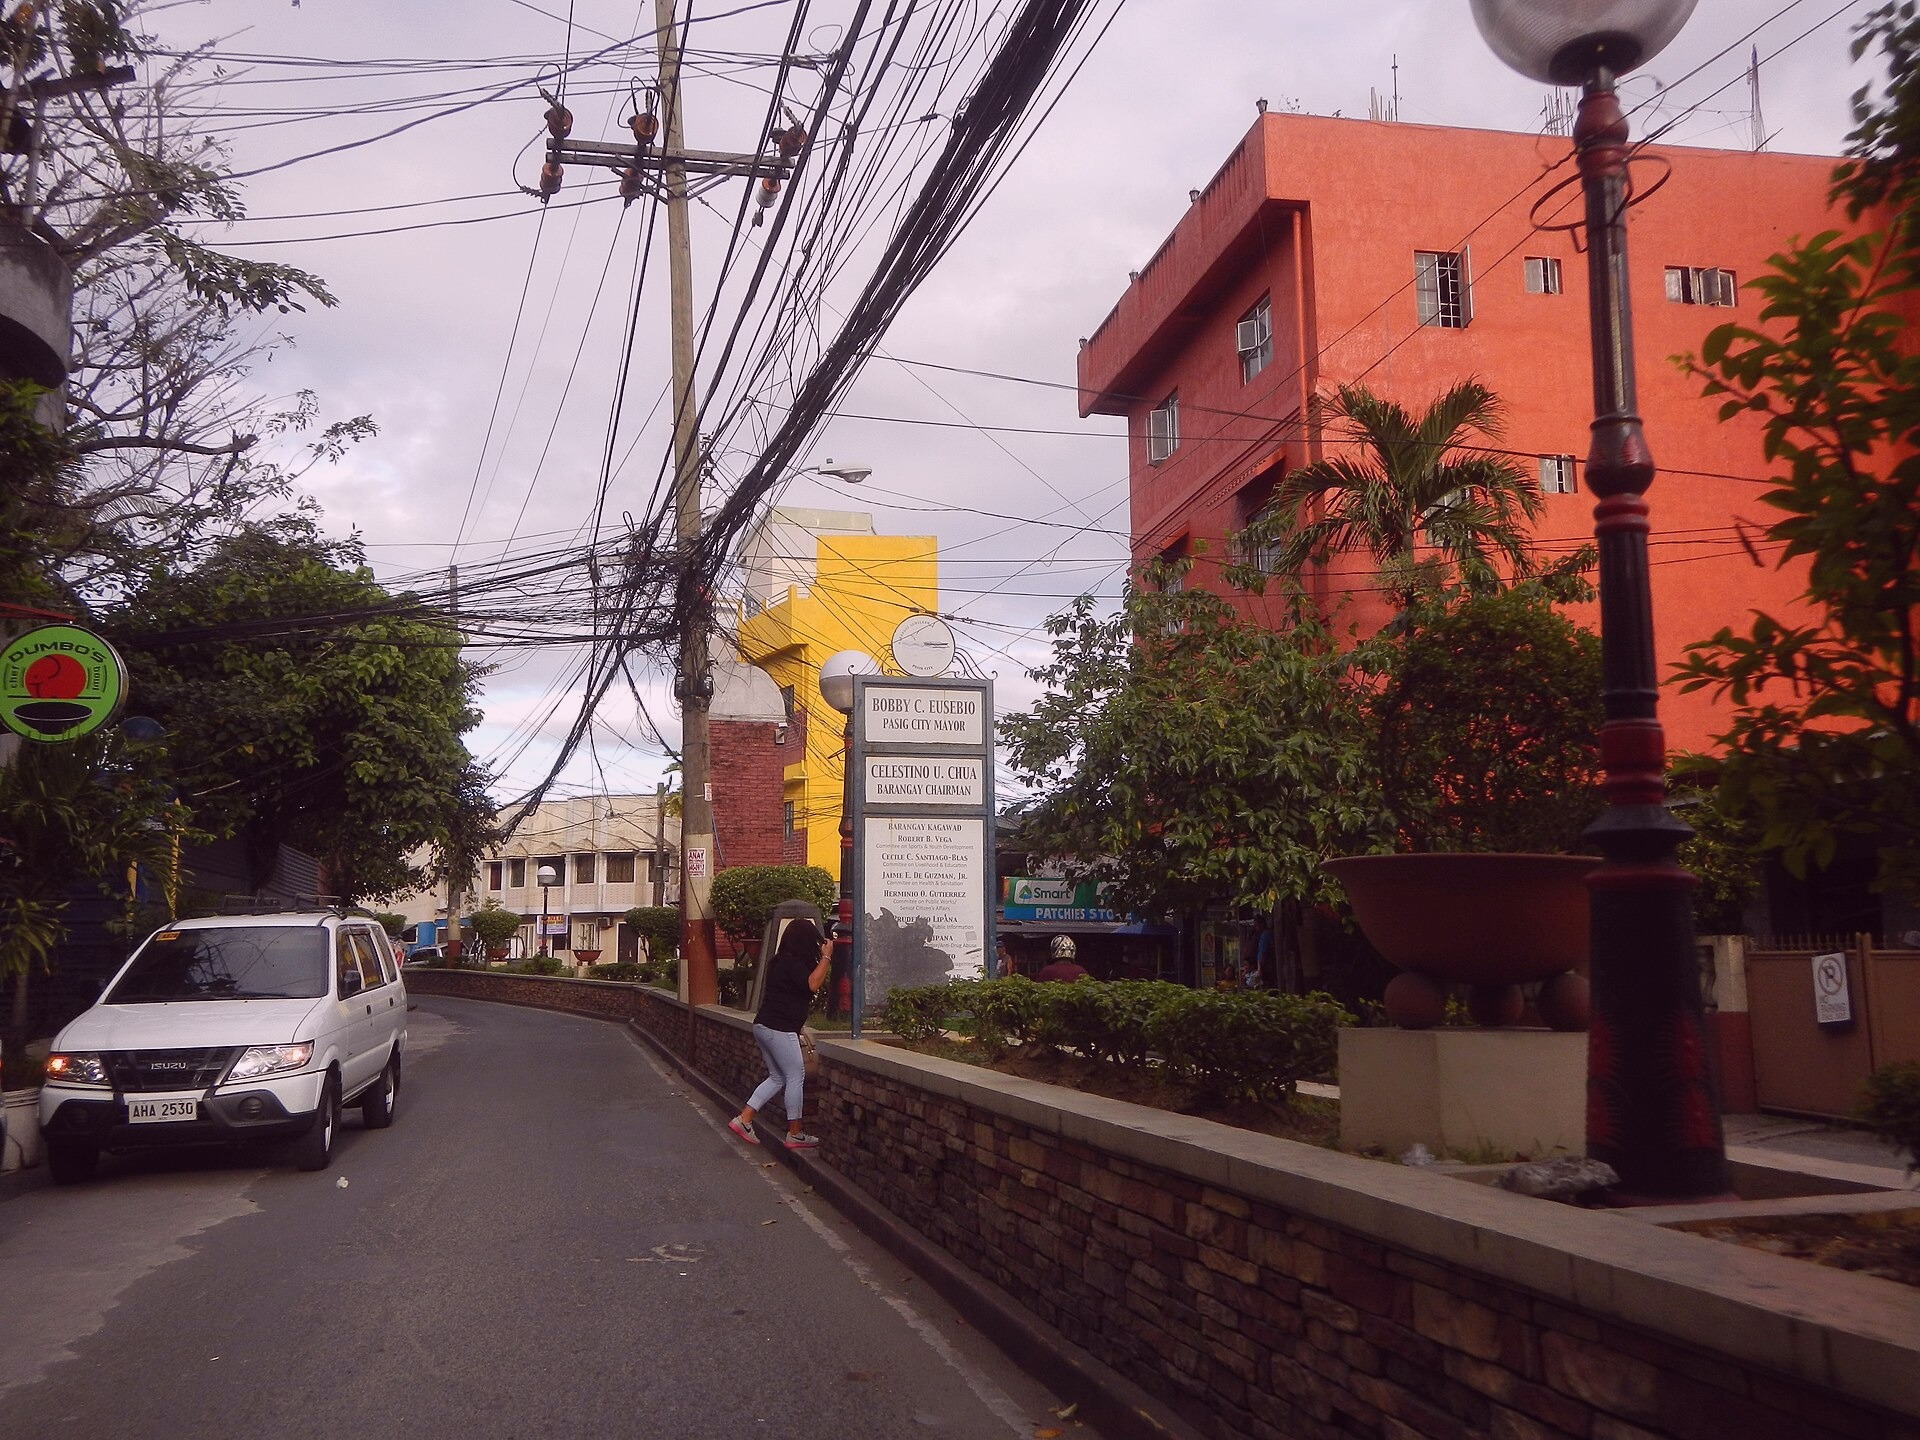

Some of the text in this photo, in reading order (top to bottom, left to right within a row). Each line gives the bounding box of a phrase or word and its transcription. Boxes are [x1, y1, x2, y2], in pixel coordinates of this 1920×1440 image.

[8, 641, 107, 663] DUMBO'S
[872, 697, 975, 715] BOBBY C. EUSEBIO
[883, 717, 965, 731] PASIG CITY MAYOR
[871, 764, 977, 780] CELESTINO U. CHUA
[877, 783, 971, 796] BARANGAY CHAIRMAN
[888, 822, 962, 832] BARANGAY KAGAWAD
[1033, 887, 1071, 899] Smart
[1035, 907, 1085, 920] PATCHIES
[151, 1062, 186, 1070] ISUZU
[133, 1102, 193, 1117] AHA 2530
